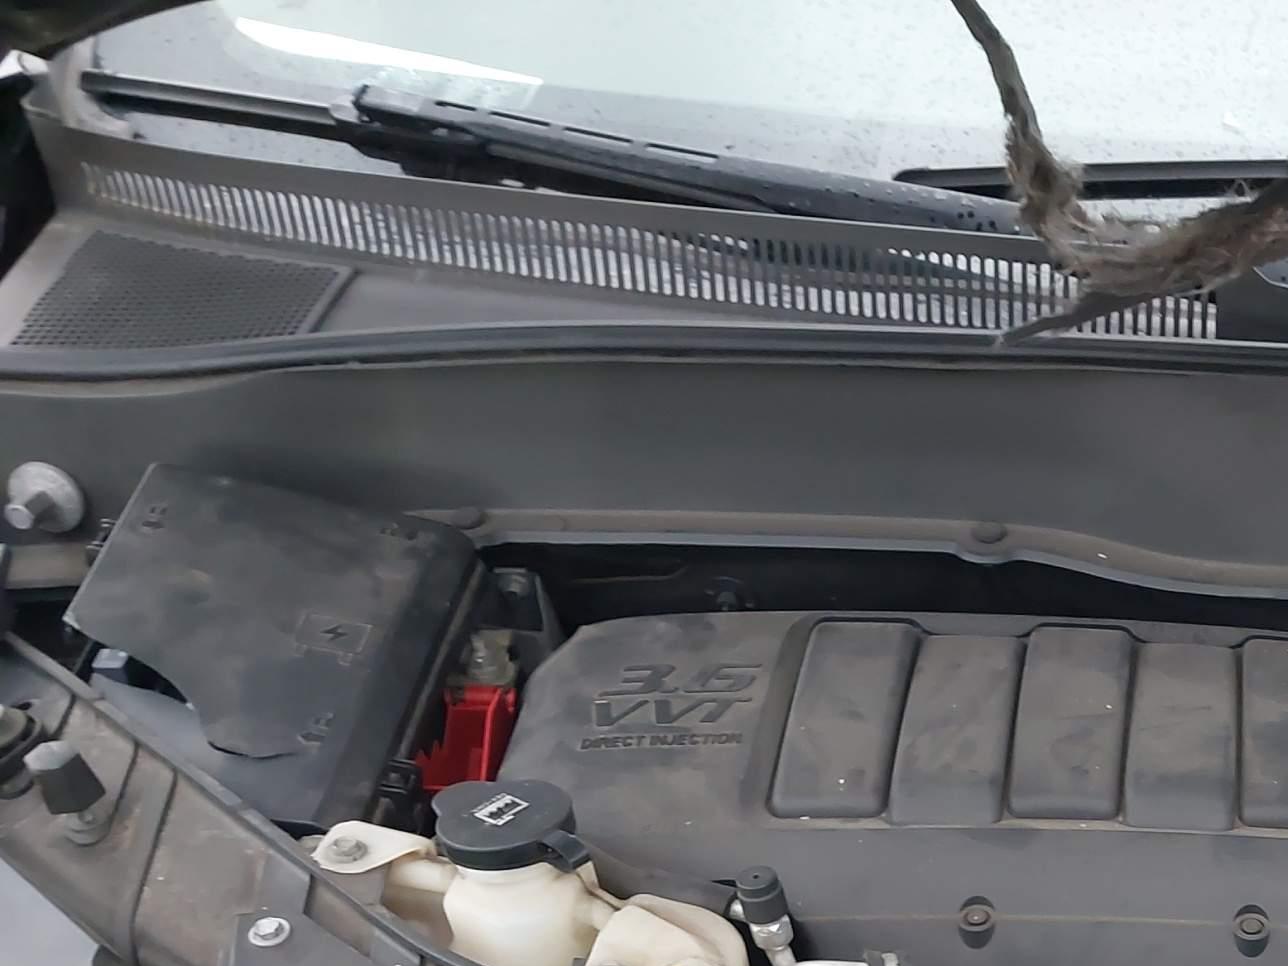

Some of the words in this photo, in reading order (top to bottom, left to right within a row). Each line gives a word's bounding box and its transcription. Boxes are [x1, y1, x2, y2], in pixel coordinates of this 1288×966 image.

[598, 663, 763, 696] 3.6
[593, 698, 753, 728] VVT
[580, 734, 645, 751] DIRECT
[650, 733, 743, 747] INJECTION
